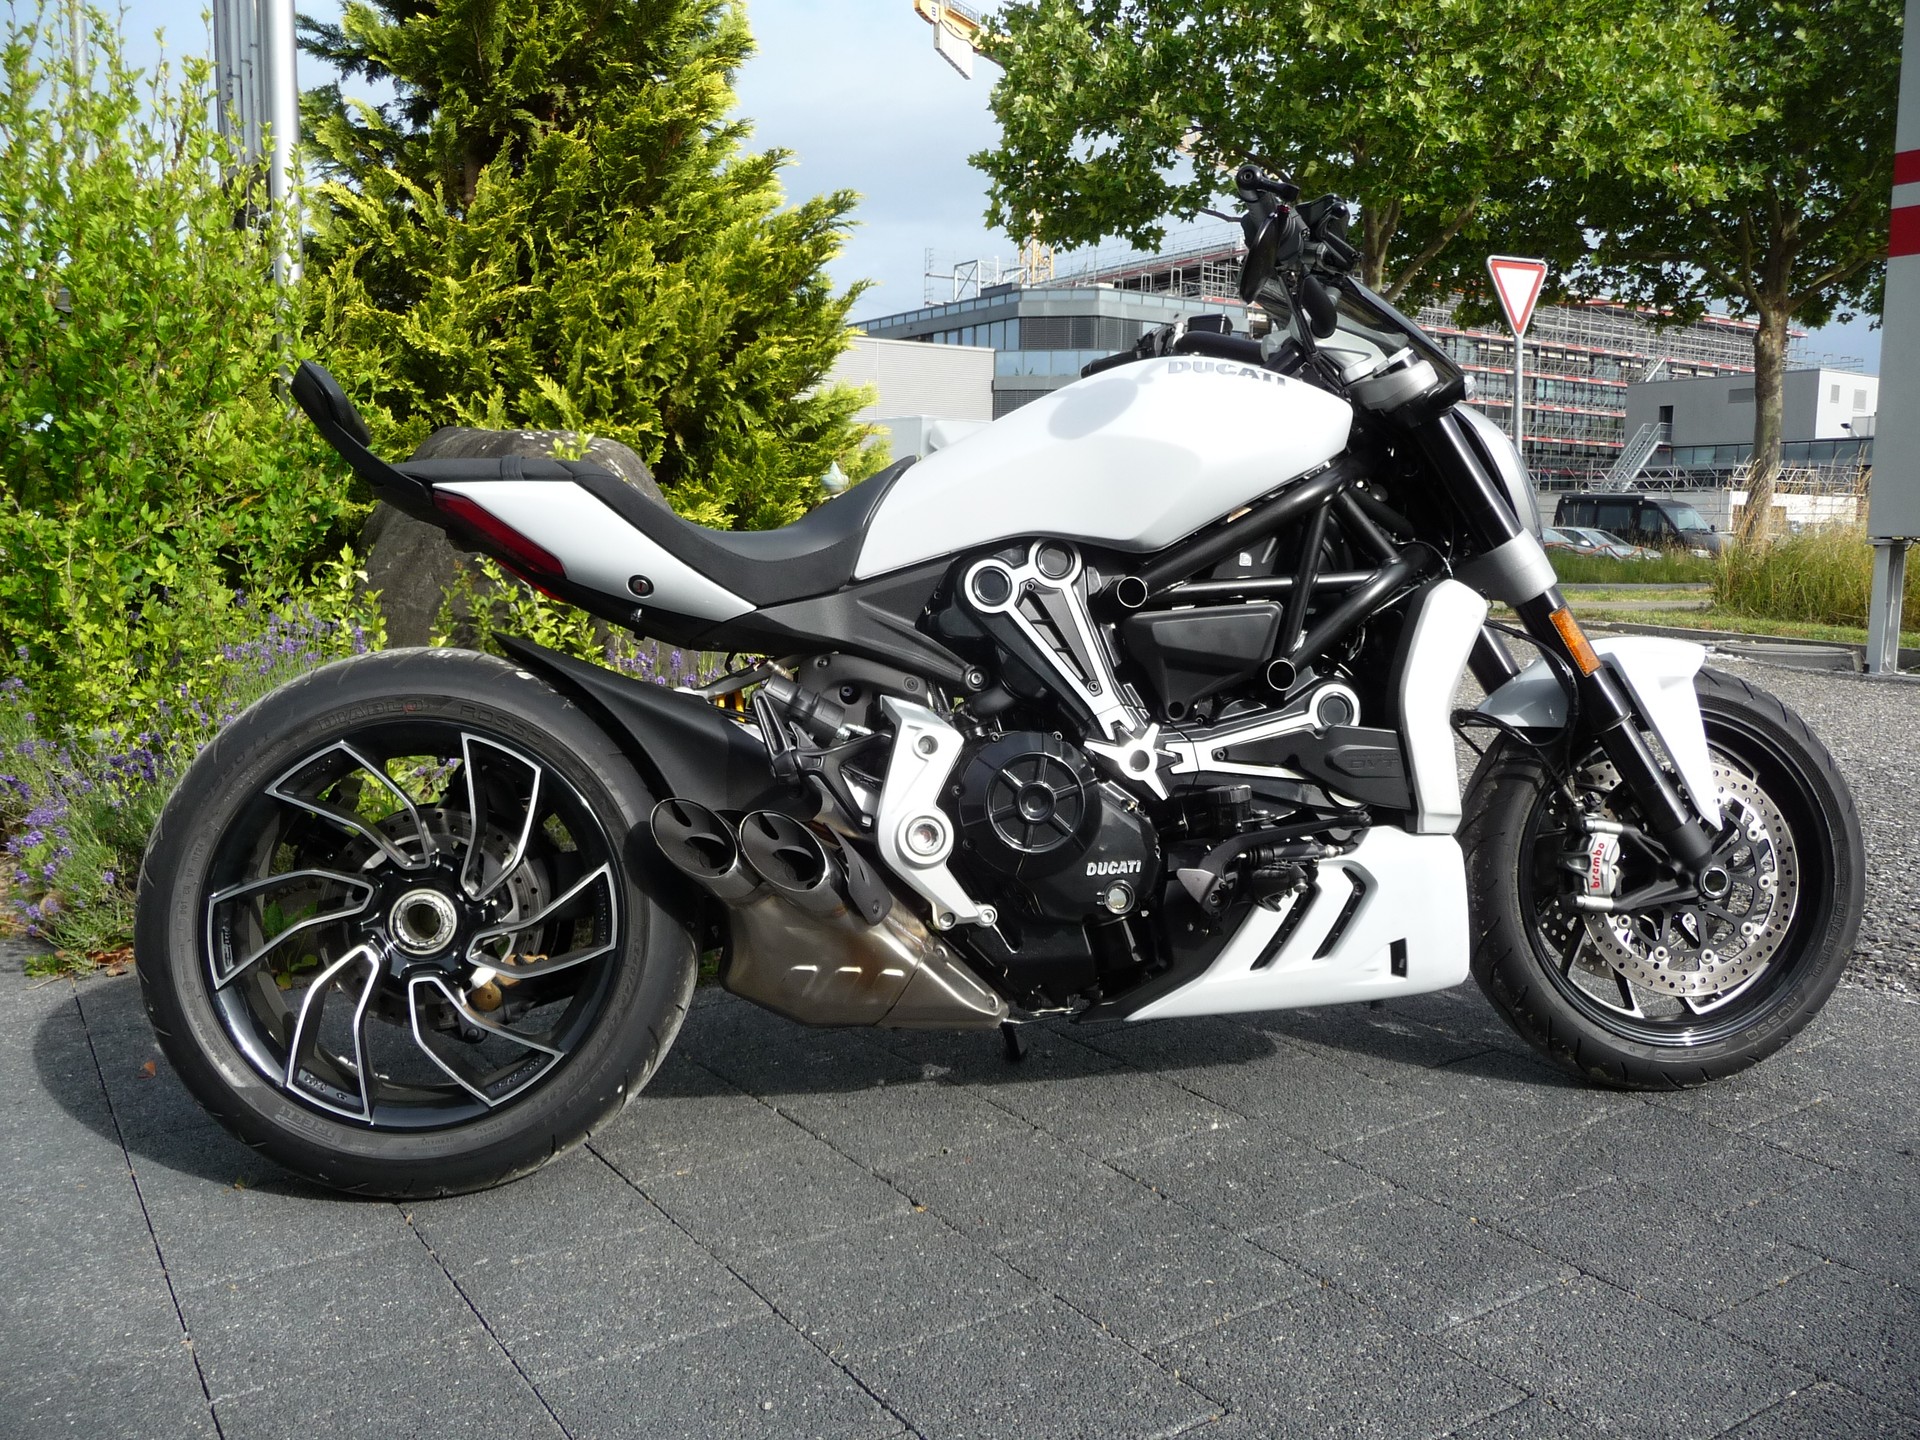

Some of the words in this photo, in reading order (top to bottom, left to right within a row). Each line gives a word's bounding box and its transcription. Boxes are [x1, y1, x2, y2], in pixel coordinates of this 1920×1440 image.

[1167, 360, 1286, 387] DUCATI
[318, 699, 424, 731] DIABLO
[458, 704, 546, 746] ROSSO
[1086, 860, 1142, 876] DUCATI
[1590, 842, 1606, 889] brembo
[1811, 902, 1846, 978] DIABLO
[1746, 994, 1802, 1042] ROSSO
